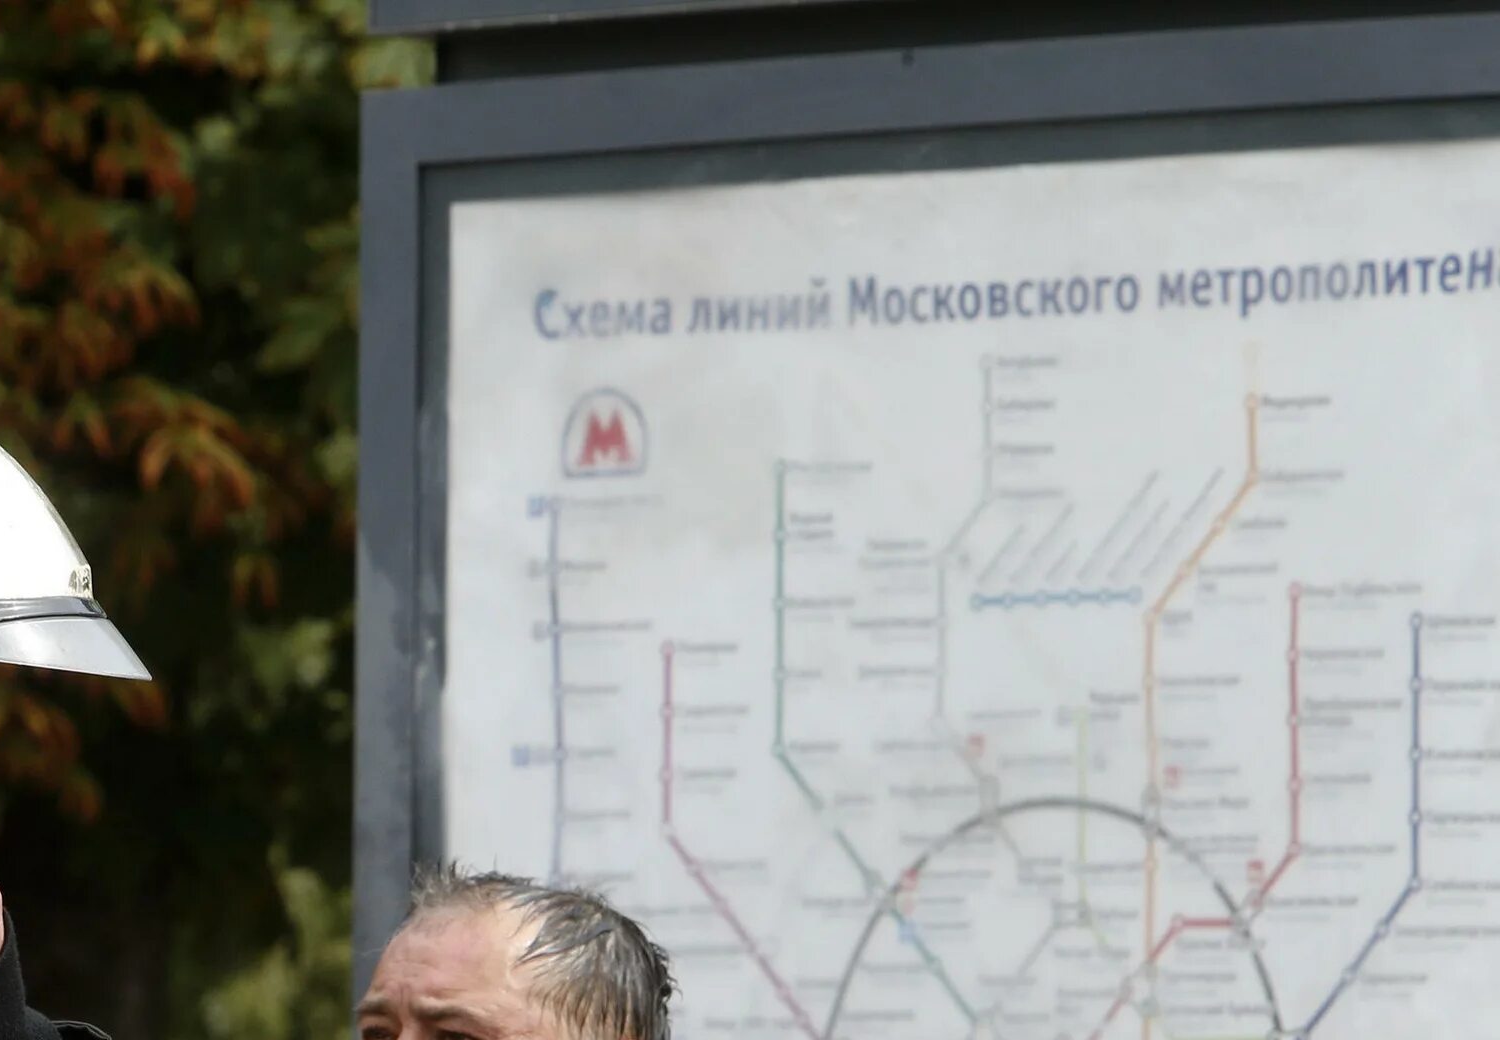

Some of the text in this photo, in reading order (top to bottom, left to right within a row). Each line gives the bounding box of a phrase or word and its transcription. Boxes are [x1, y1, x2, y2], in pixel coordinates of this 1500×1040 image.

[533, 246, 1500, 340] Схема линий Московского метрополитен
